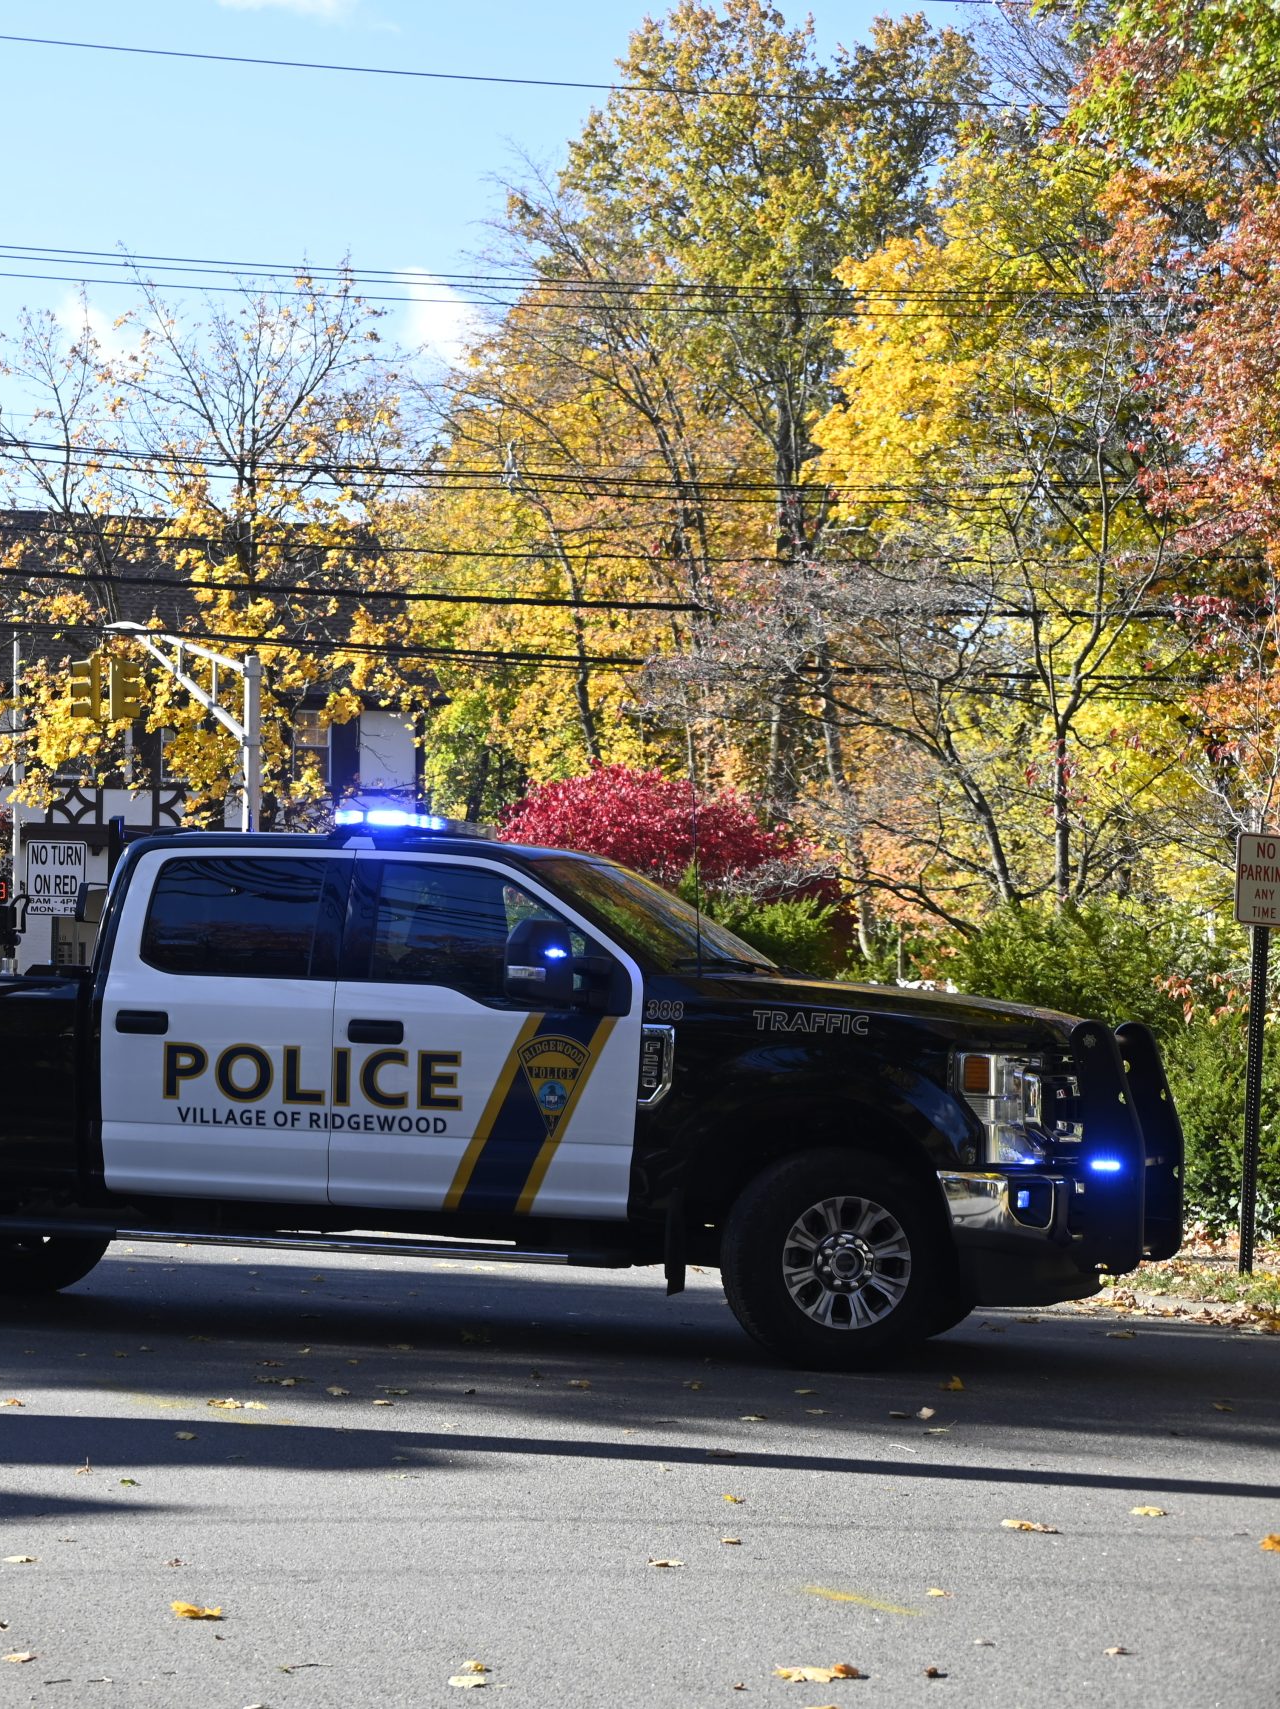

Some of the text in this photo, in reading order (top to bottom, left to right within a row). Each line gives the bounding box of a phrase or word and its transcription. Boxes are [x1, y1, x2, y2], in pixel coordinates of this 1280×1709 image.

[31, 845, 82, 866] NO TURN
[1257, 842, 1276, 859] NO
[1241, 864, 1280, 883] PARKIN
[0, 881, 6, 899] 3
[34, 874, 51, 894] ON
[54, 875, 78, 895] RED
[1254, 888, 1275, 900] ANY
[1252, 906, 1277, 919] TIME
[646, 999, 684, 1020] 388
[752, 1010, 870, 1035] TRAFFIC
[523, 1040, 584, 1063] RIDGEWOOD
[163, 1041, 463, 1111] POLICE
[532, 1067, 574, 1079] POLICE
[177, 1107, 448, 1135] VILLAGE OF RIDGEWOOD
